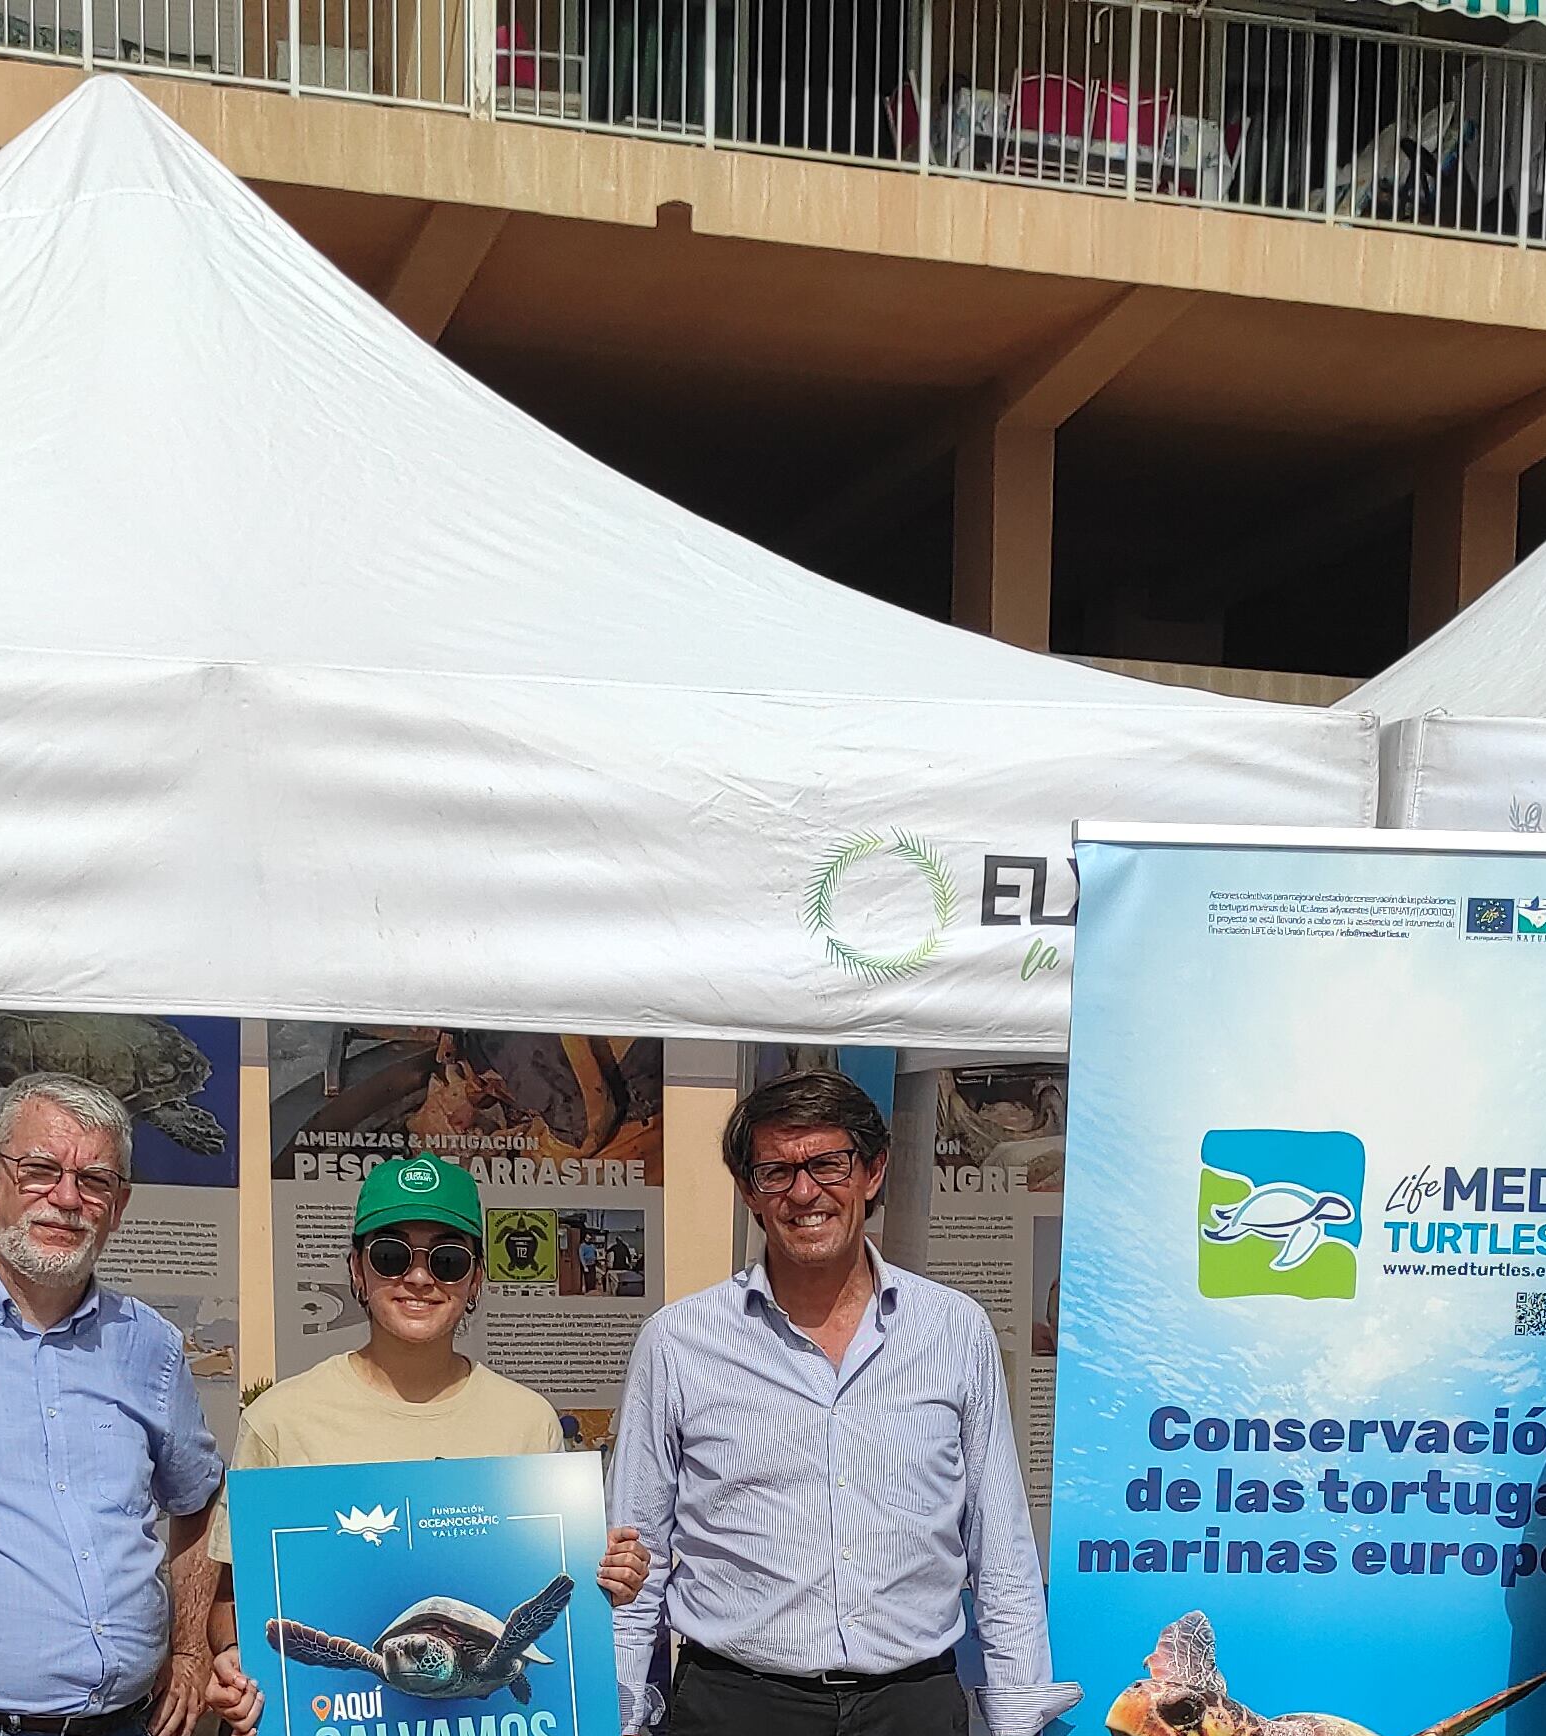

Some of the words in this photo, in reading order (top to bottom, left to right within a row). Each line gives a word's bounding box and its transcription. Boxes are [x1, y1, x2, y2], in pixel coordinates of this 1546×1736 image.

[1019, 936, 1062, 982] la
[294, 1130, 405, 1149] AMENAZAS
[407, 1133, 423, 1149] &
[425, 1132, 541, 1151] MITIGACIÓN
[468, 1158, 646, 1187] ARRASTRE
[1125, 1467, 1203, 1513] de
[1216, 1468, 1306, 1515] las
[432, 1505, 485, 1516] FUNDACIÓN
[1077, 1526, 1339, 1576] marinas
[332, 1684, 384, 1722] AQUÍ
